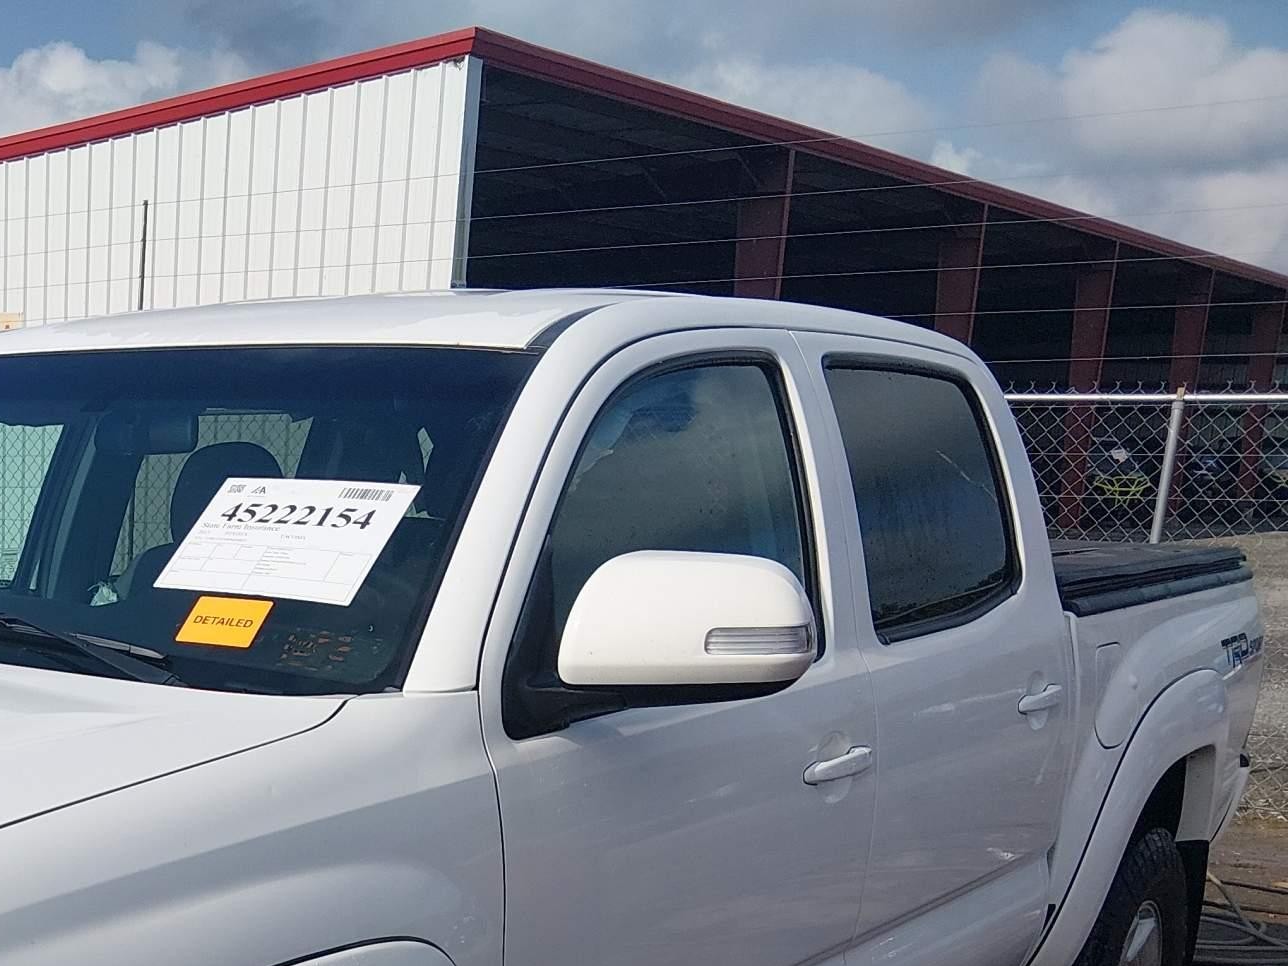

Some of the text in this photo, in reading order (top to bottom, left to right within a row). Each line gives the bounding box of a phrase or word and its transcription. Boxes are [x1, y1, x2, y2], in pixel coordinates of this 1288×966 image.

[221, 502, 377, 530] 45222154
[193, 615, 254, 629] DETAILED
[1220, 632, 1249, 668] TRD
